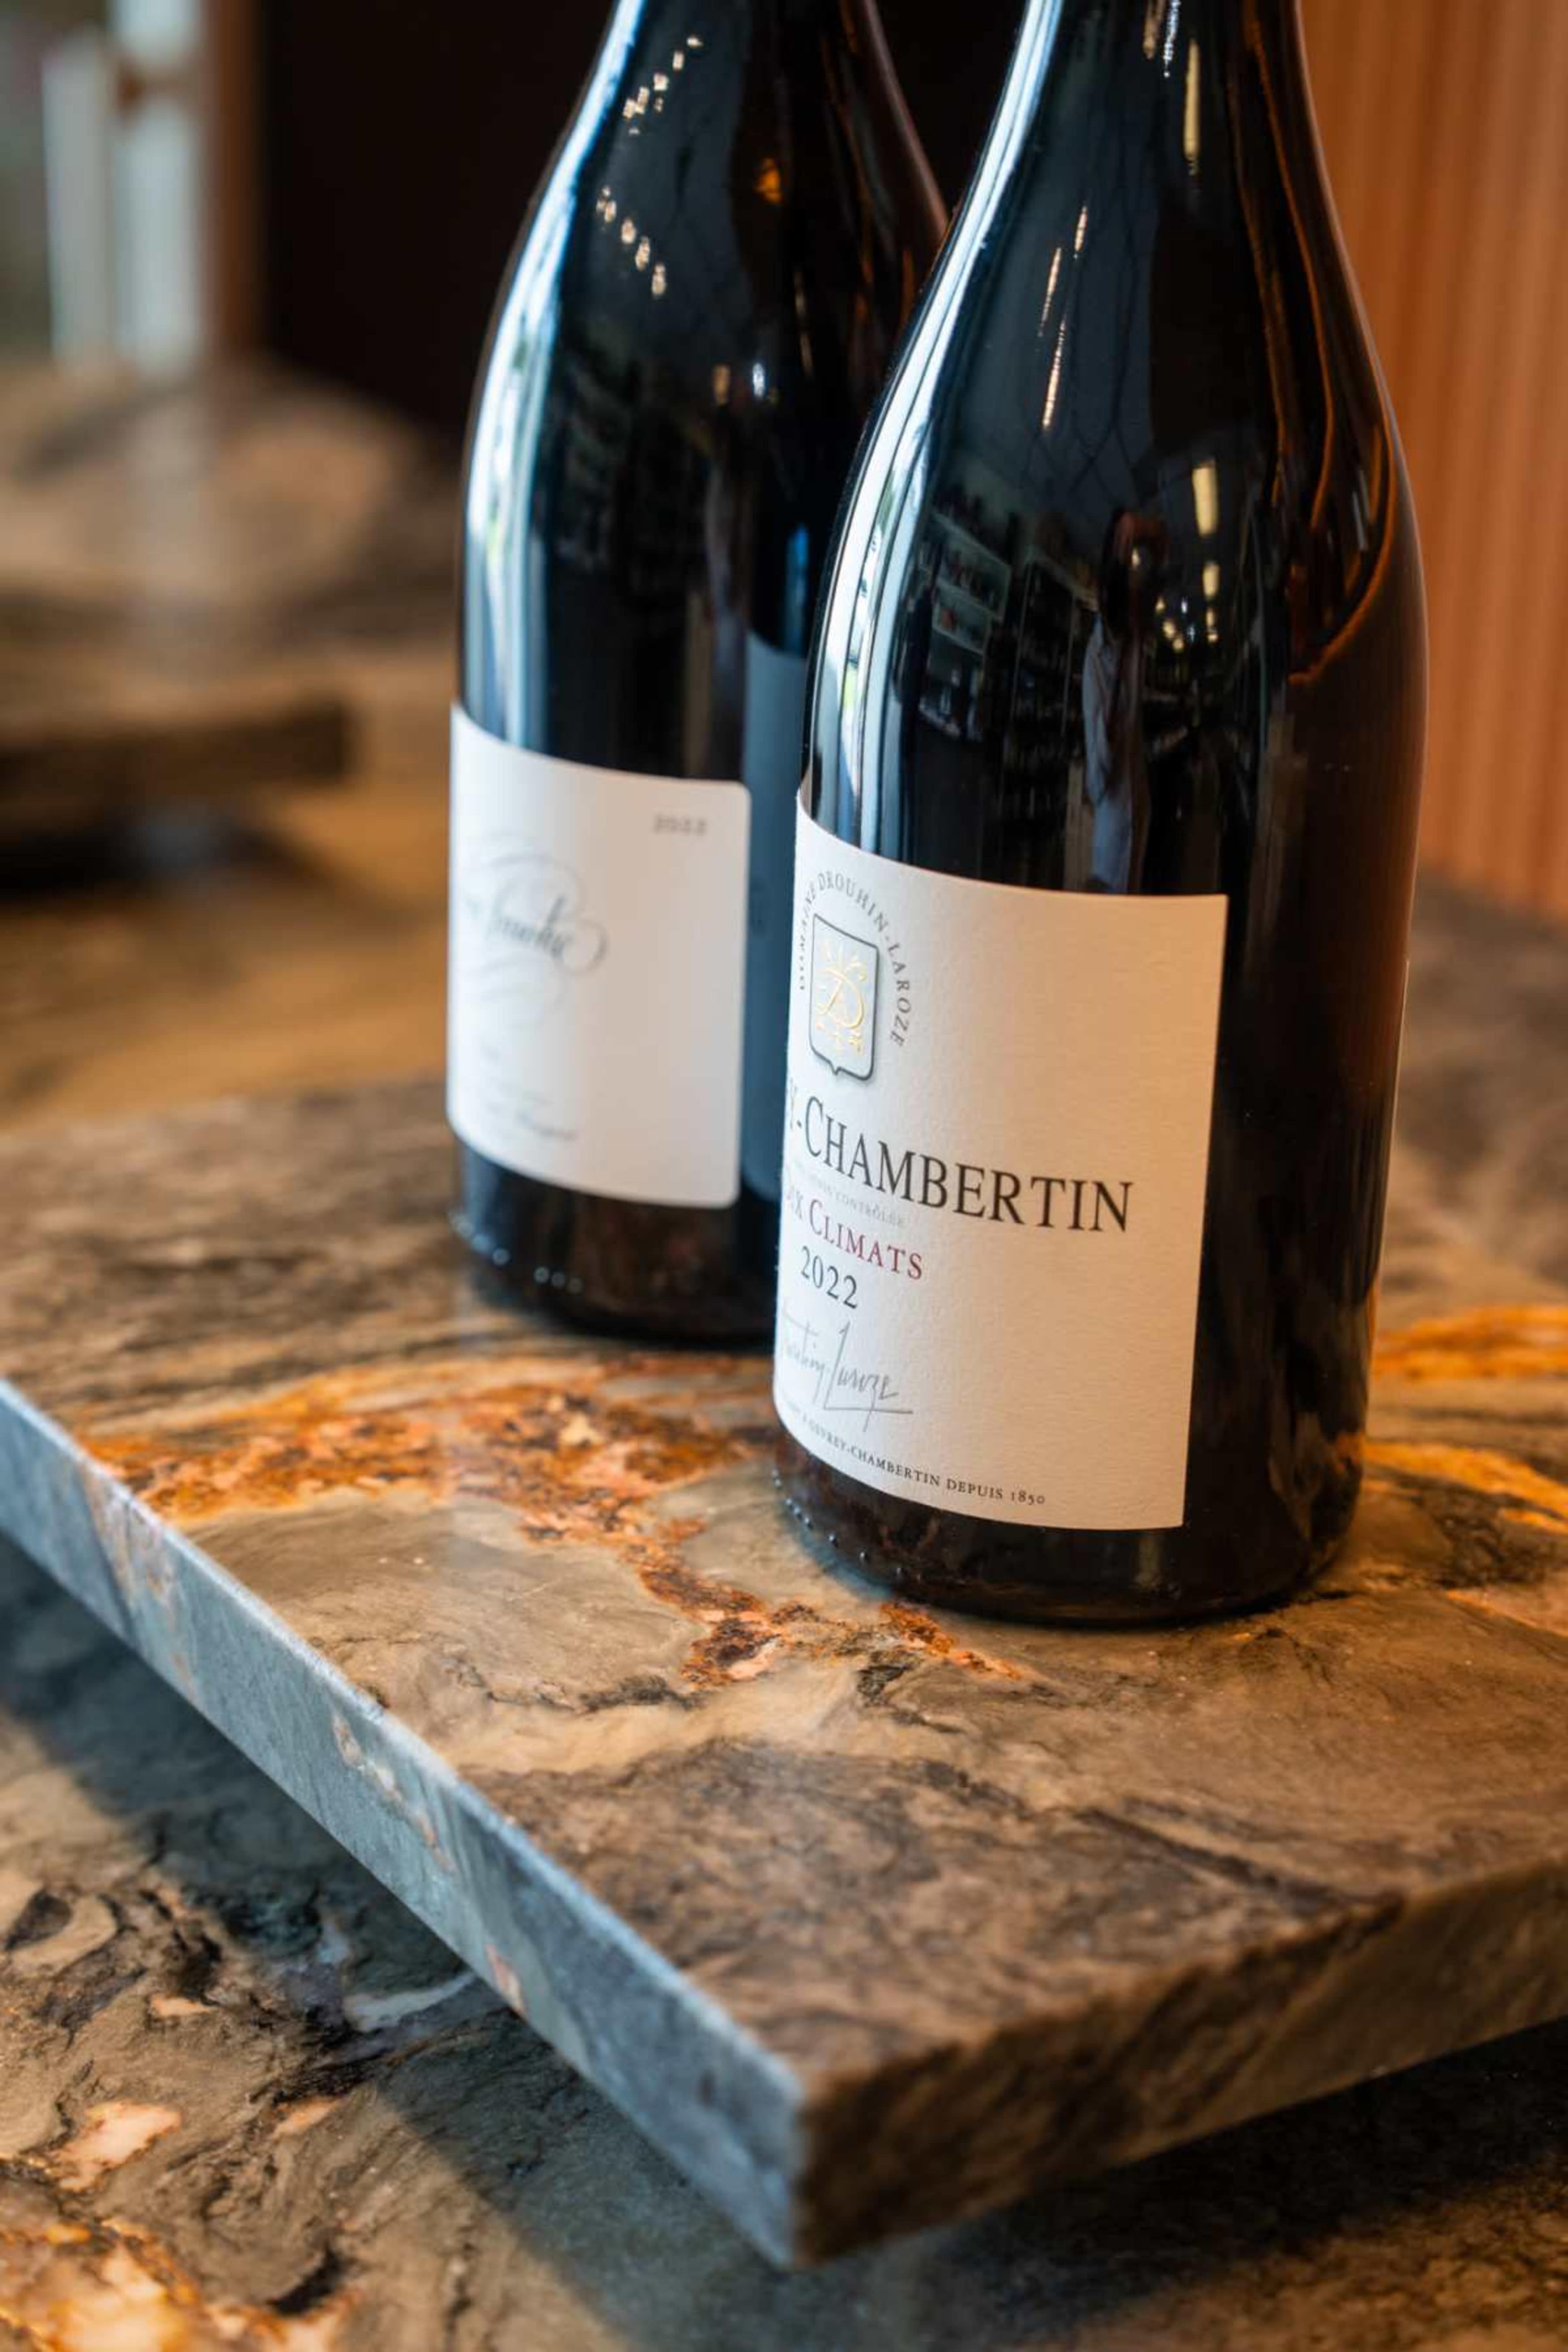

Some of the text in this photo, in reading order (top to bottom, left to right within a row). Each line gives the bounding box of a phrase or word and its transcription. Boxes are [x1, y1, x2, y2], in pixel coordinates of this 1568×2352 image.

[818, 870, 912, 1047] DROUHIN-LAROZE
[810, 1199, 922, 1280] CLIMATS
[801, 1246, 857, 1309] 2022
[946, 1479, 1003, 1499] DEPUIS
[1010, 1490, 1045, 1506] 1850
